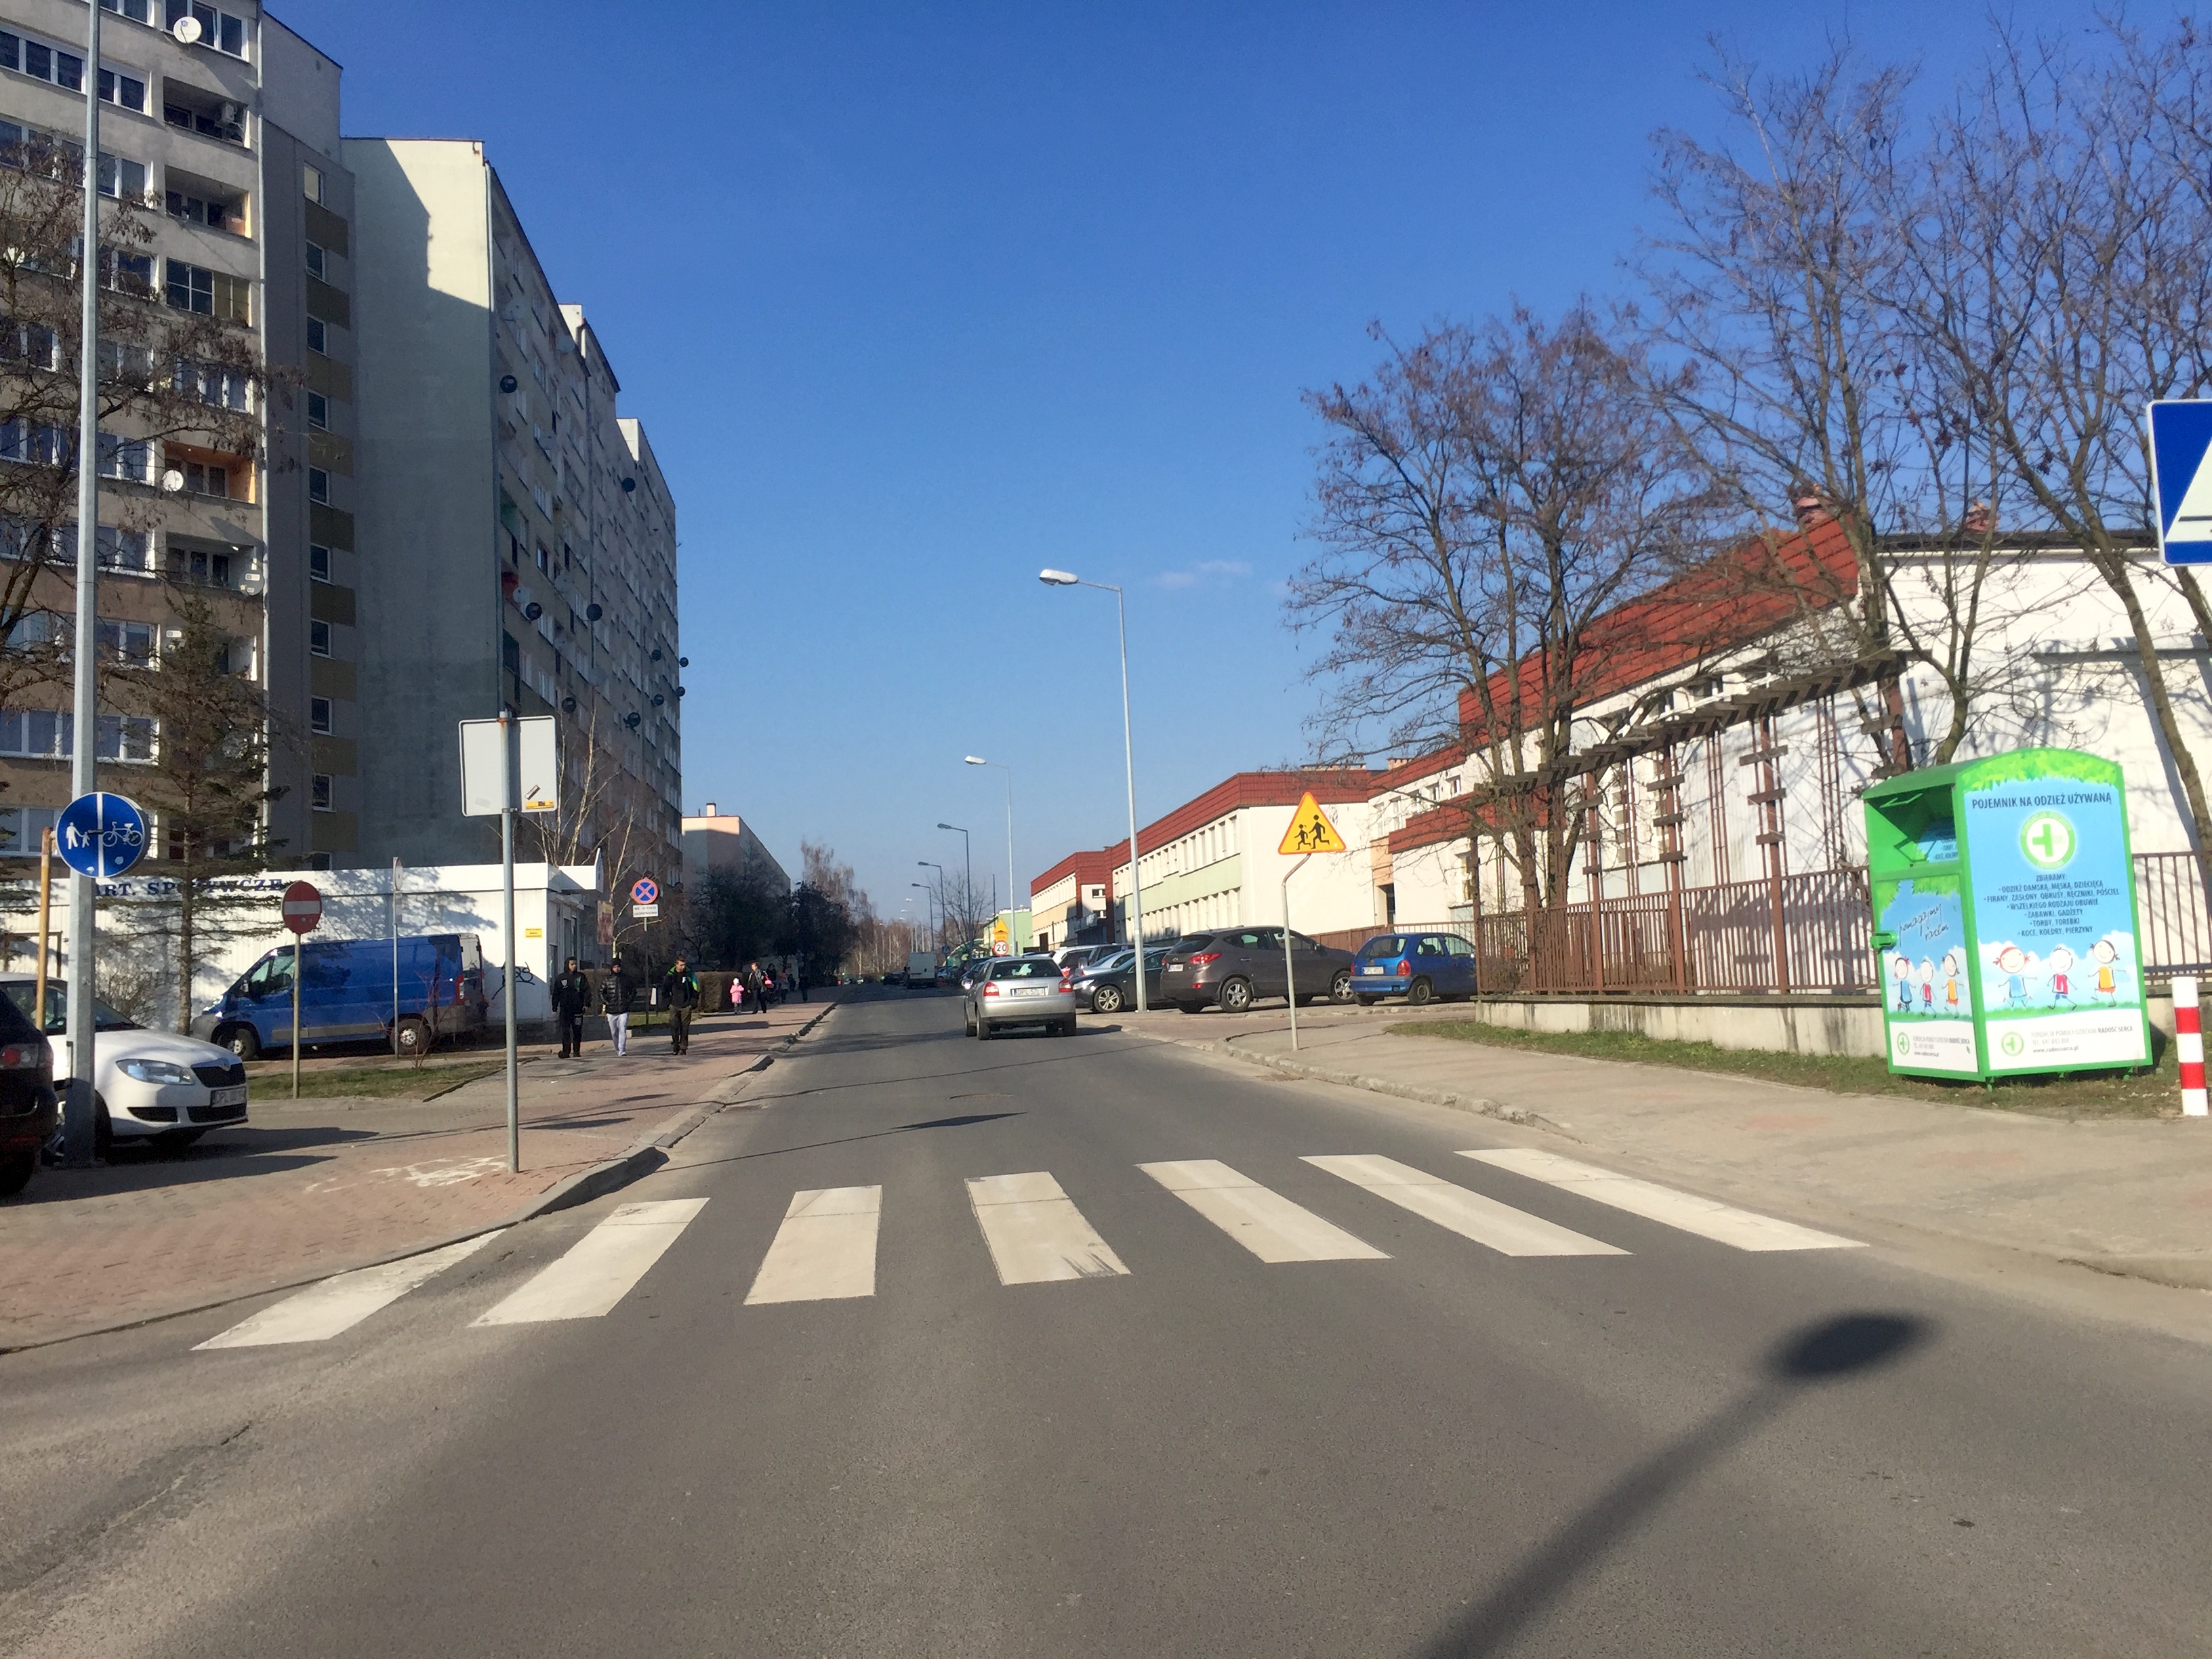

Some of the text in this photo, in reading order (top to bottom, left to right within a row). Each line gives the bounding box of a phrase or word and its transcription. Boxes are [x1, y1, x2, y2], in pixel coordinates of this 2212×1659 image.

[1971, 792, 2112, 809] POJEMNIK NA ODZIEŻ UŻYWANĄ
[2048, 900, 2074, 908] RODZAJU
[2055, 918, 2080, 926] TOREBKI
